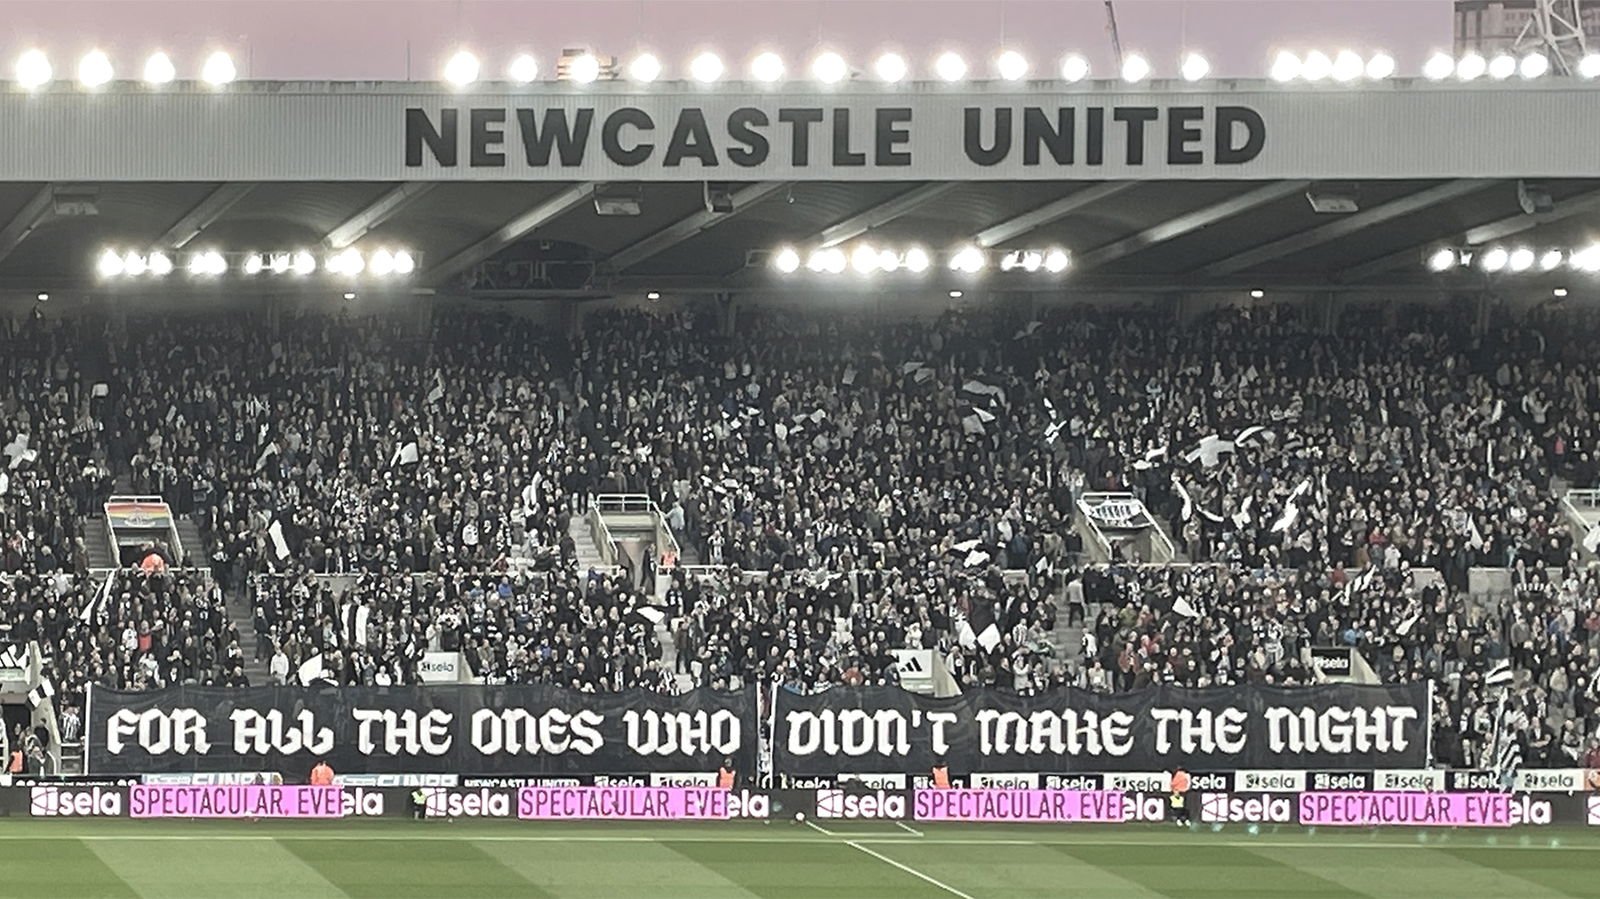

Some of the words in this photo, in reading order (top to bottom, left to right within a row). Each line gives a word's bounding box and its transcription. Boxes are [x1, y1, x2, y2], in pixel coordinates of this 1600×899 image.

[405, 106, 912, 167] NEWCASTLE
[963, 106, 1266, 167] UNITED
[106, 708, 212, 755] FOR
[229, 708, 335, 755] ALL
[352, 707, 453, 755] THE
[471, 708, 605, 755] ONES
[623, 708, 741, 756] WHO
[785, 708, 958, 756] DIDN'T
[975, 708, 1135, 756] MAKE
[1150, 707, 1248, 754] THE
[1264, 706, 1418, 754] NIGHT
[1061, 776, 1096, 790] sela
[1130, 777, 1162, 791] sela
[1192, 774, 1226, 789] sela
[1261, 775, 1295, 788] sela
[1331, 773, 1365, 788] sela
[1541, 774, 1574, 787] sela
[59, 787, 121, 815] sela
[448, 788, 510, 816] sela
[844, 790, 905, 818] sela
[1229, 794, 1290, 822] sela
